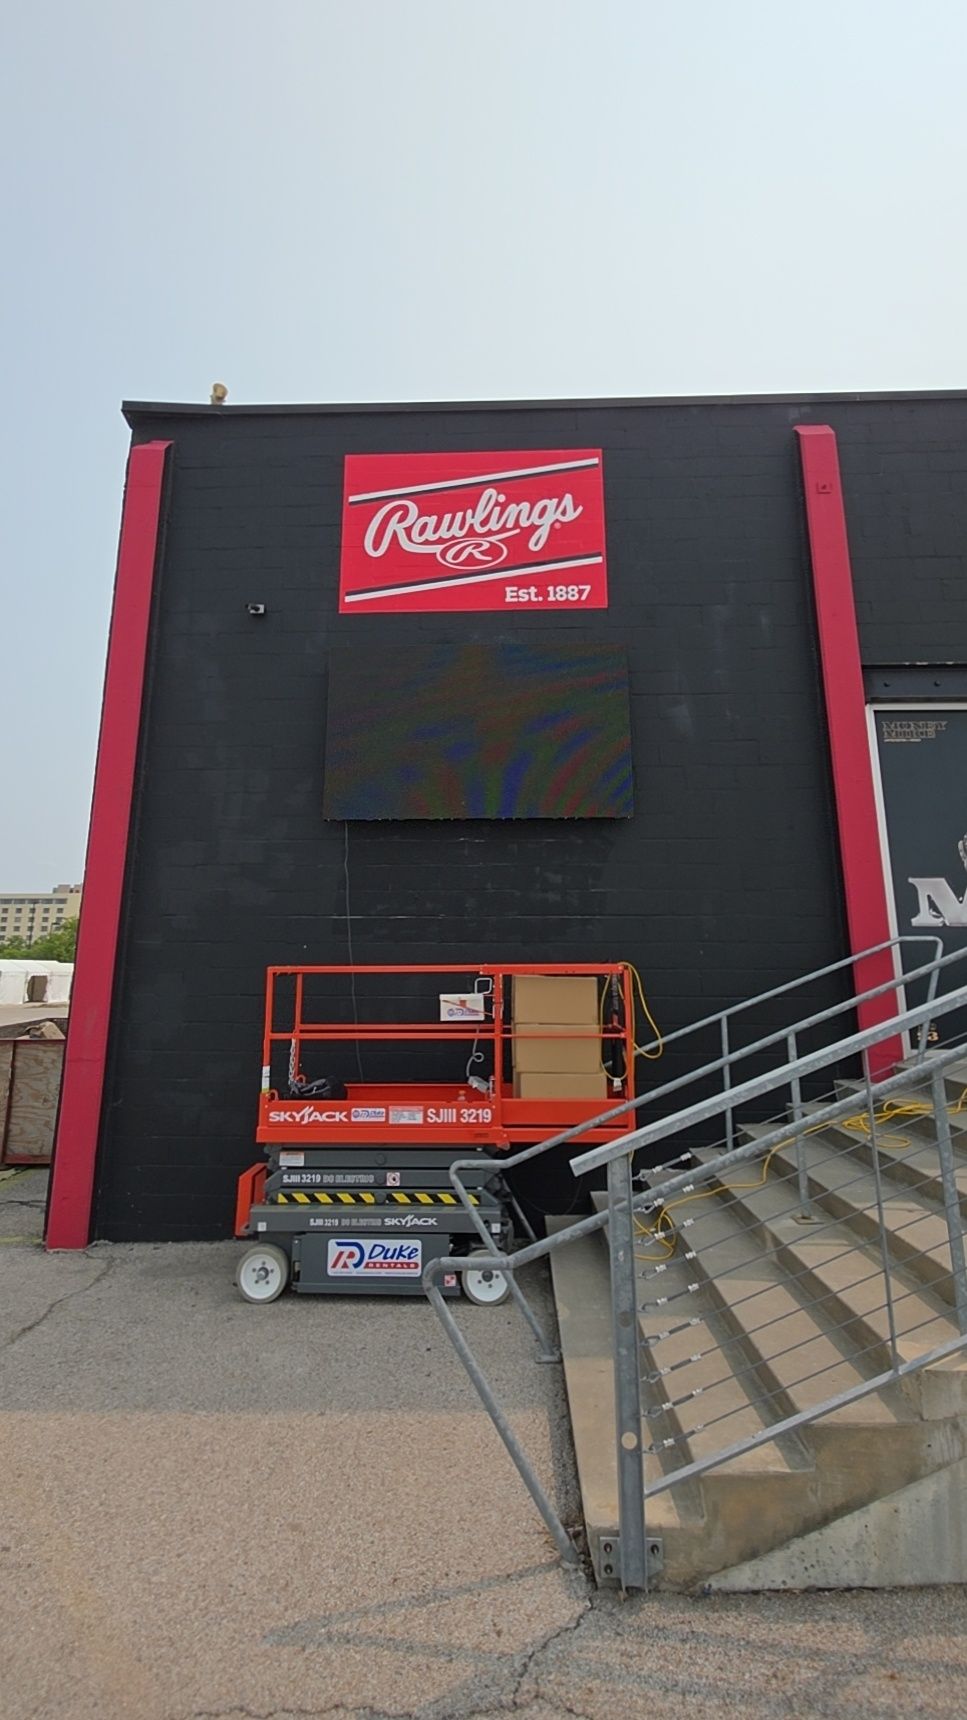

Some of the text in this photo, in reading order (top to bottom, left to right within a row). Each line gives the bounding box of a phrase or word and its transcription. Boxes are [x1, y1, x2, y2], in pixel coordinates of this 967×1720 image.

[364, 488, 583, 557] Rawlings
[505, 585, 591, 602] Est. 1887
[269, 1106, 348, 1125] SKYJACK
[427, 1108, 457, 1123] SJIII
[460, 1108, 492, 1123] 3219
[301, 1174, 321, 1183] 3219
[384, 1214, 438, 1227] SKYJACK
